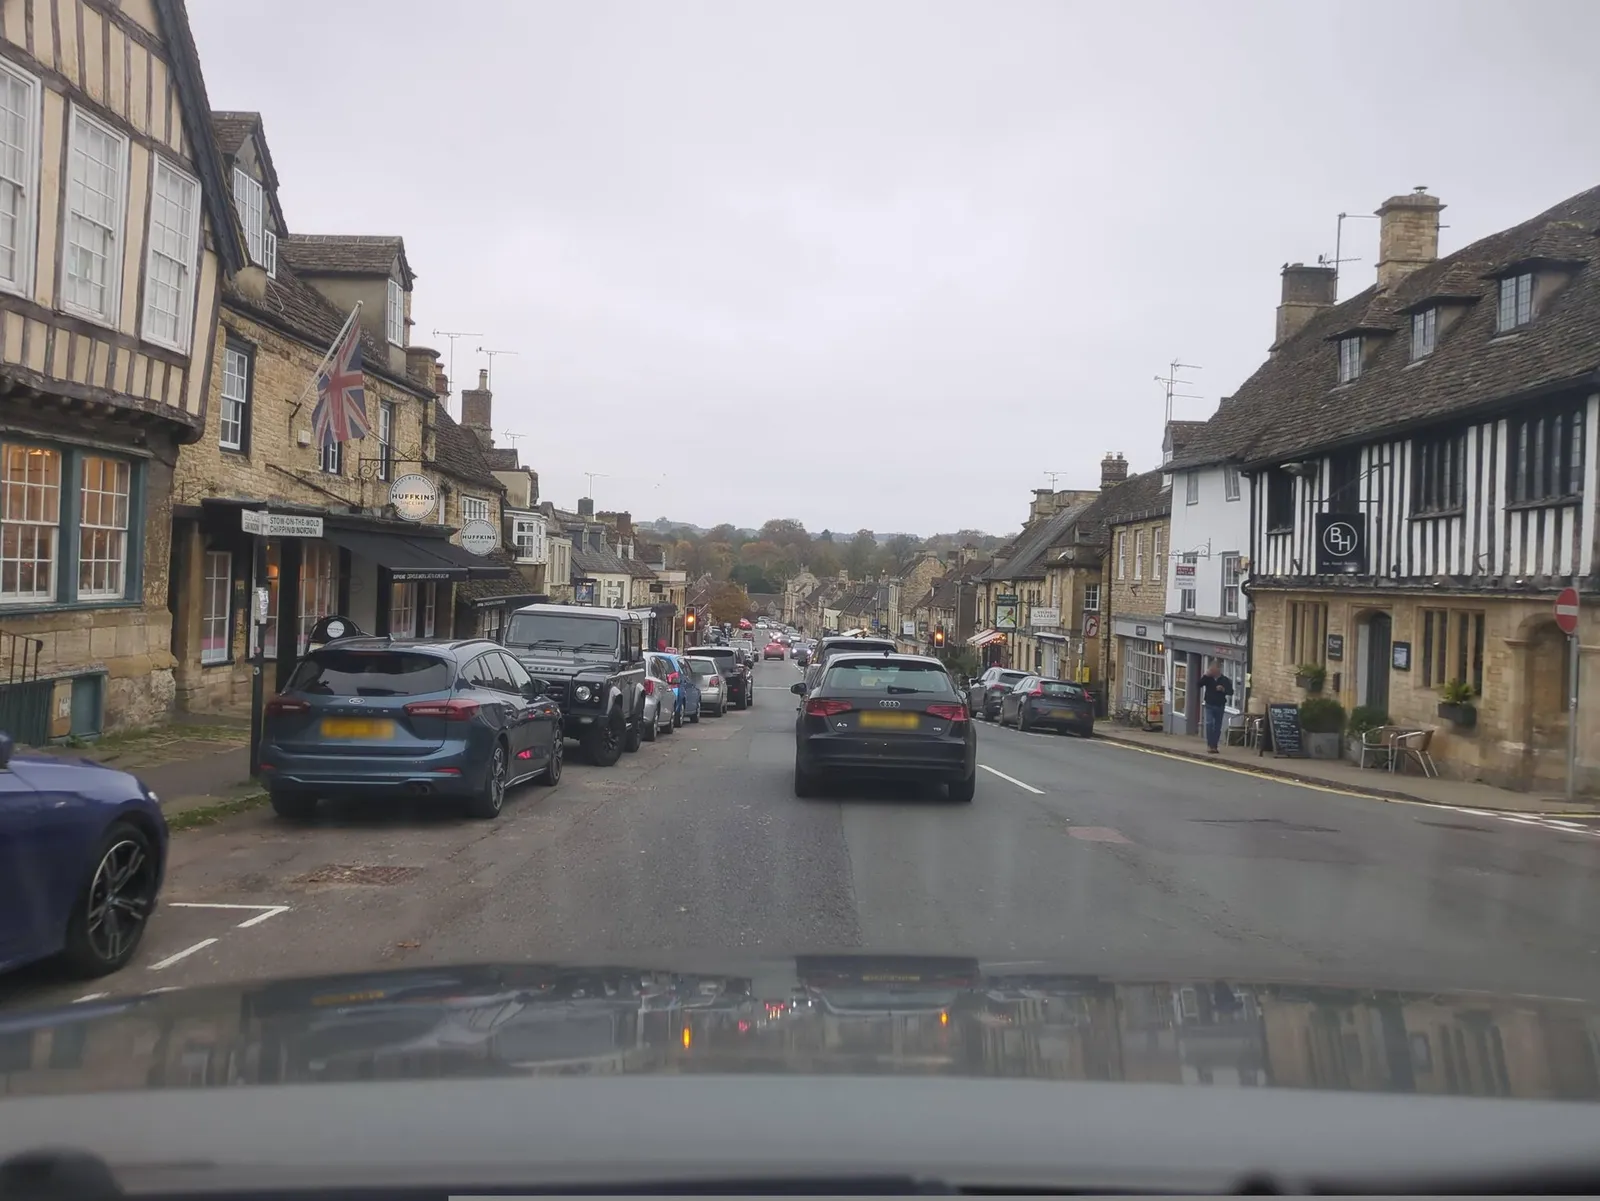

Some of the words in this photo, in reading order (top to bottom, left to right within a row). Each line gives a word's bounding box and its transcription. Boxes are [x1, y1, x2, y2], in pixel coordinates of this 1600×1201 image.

[391, 493, 435, 501] HUFFKINS
[269, 525, 295, 534] CHIPPING
[295, 526, 318, 535] NORTON
[1330, 527, 1350, 551] BH
